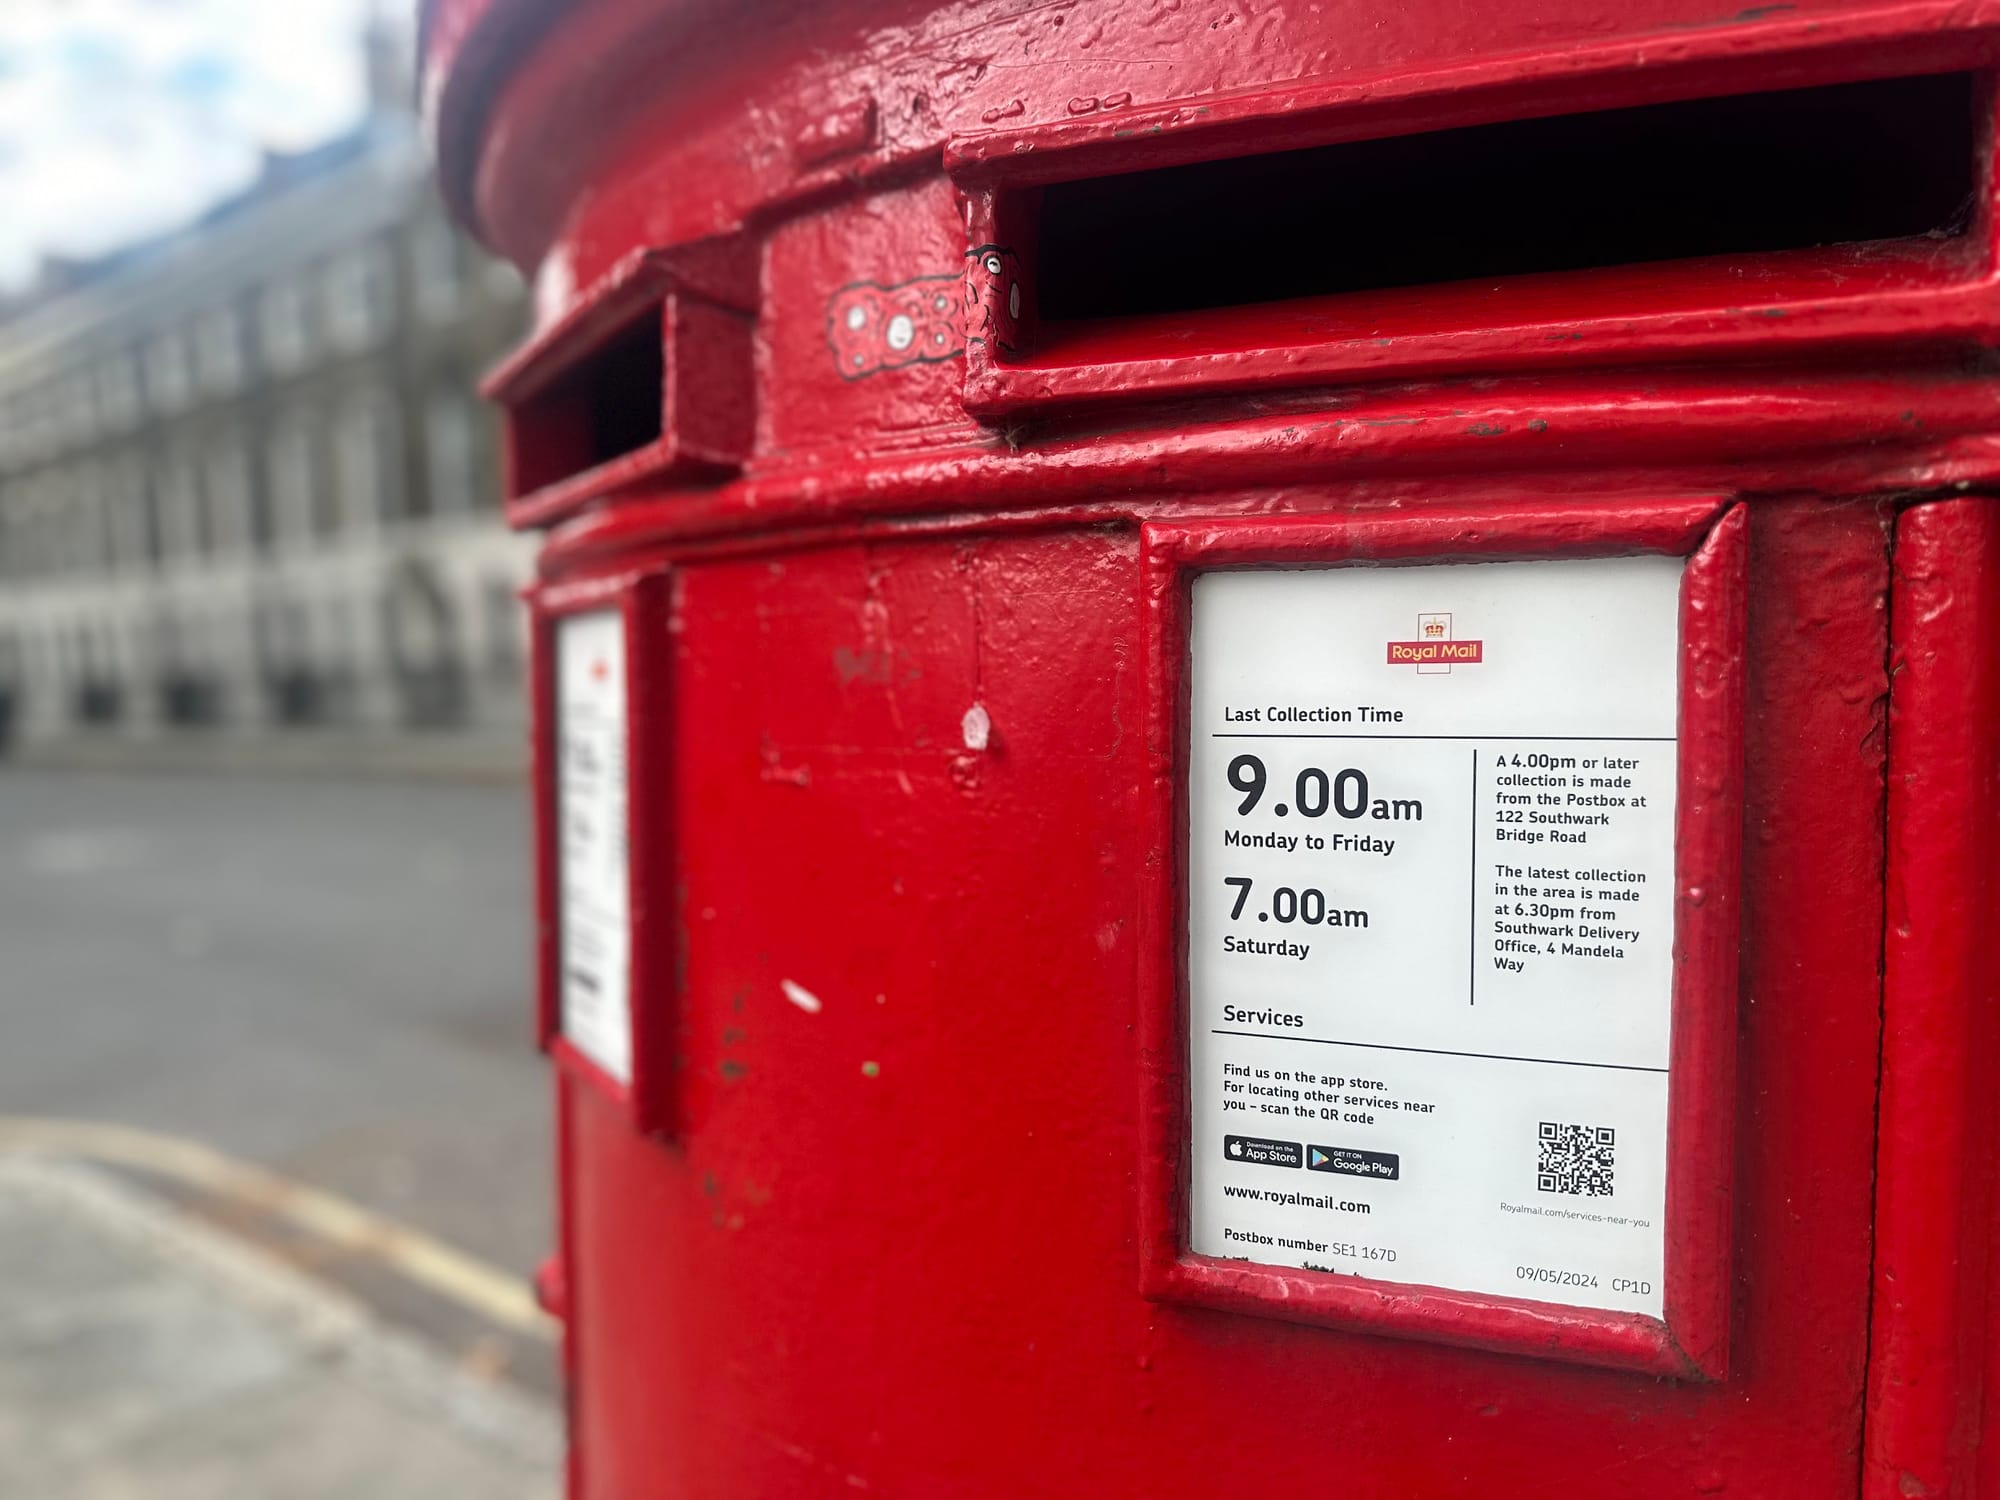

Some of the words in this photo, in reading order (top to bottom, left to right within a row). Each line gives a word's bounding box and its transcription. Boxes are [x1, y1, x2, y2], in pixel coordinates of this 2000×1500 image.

[1392, 644, 1437, 662] Royal
[1440, 643, 1477, 658] Mail
[1225, 706, 1261, 722] Last
[1267, 706, 1352, 723] Collection
[1357, 706, 1404, 723] Time
[1496, 755, 1507, 768] A
[1511, 753, 1576, 772] 4.00pm
[1582, 759, 1599, 769] or
[1603, 756, 1640, 770] later
[1226, 754, 1423, 821] 9.00am
[1496, 773, 1567, 787] collection
[1572, 774, 1585, 788] is
[1589, 775, 1632, 789] made
[1496, 791, 1532, 805] from
[1536, 792, 1561, 806] the
[1567, 793, 1626, 807] Postbox
[1630, 795, 1647, 808] at
[1495, 810, 1524, 823] 122
[1528, 810, 1610, 826] Southwark
[1224, 829, 1299, 853] Monday
[1304, 834, 1325, 850] to
[1333, 833, 1395, 857] Friday
[1496, 828, 1544, 845] Bridge
[1549, 829, 1587, 844] Road
[1494, 864, 1523, 878] The
[1527, 866, 1570, 880] latest
[1574, 868, 1646, 883] collection
[1495, 882, 1508, 896] in
[1513, 884, 1538, 897] the
[1542, 888, 1576, 899] area
[1581, 886, 1593, 900] is
[1598, 888, 1640, 902] made
[1223, 876, 1369, 929] 7.00am
[1494, 904, 1510, 916] at
[1514, 902, 1575, 921] 6.30pm
[1579, 906, 1616, 921] from
[1494, 920, 1574, 937] Southwark
[1578, 925, 1640, 943] Delivery
[1223, 935, 1310, 961] Saturday
[1494, 938, 1541, 955] Office,
[1546, 941, 1556, 955] 4
[1561, 942, 1624, 959] Mandela
[1493, 956, 1525, 974] Way
[1223, 1004, 1304, 1028] Services
[1223, 1063, 1251, 1077] Find
[1255, 1069, 1270, 1079] us
[1274, 1071, 1290, 1081] on
[1294, 1071, 1316, 1084] the
[1320, 1075, 1345, 1089] app
[1349, 1077, 1388, 1091] store.
[1223, 1079, 1245, 1094] For
[1248, 1082, 1299, 1102] locating
[1303, 1090, 1340, 1104] other
[1343, 1095, 1399, 1110] services
[1403, 1102, 1436, 1113] near
[1223, 1099, 1246, 1111] you
[1260, 1103, 1290, 1116] scan
[1294, 1105, 1316, 1119] the
[1320, 1107, 1339, 1121] QR
[1343, 1112, 1375, 1125] code
[1245, 1147, 1268, 1161] App
[1268, 1150, 1297, 1163] Store
[1246, 1141, 1275, 1150] Download
[1333, 1150, 1346, 1158] GET
[1352, 1152, 1362, 1160] ON
[1333, 1157, 1371, 1174] Google
[1372, 1162, 1394, 1177] Play
[1223, 1185, 1371, 1215] www.royalmail.com
[1500, 1201, 1650, 1229] Royalmail.com/services-near-you
[1224, 1227, 1274, 1246] Postbox
[1277, 1238, 1329, 1253] number
[1332, 1242, 1357, 1258] SE1
[1361, 1246, 1397, 1262] 167D
[1516, 1266, 1598, 1289] 09/05/2024
[1612, 1278, 1651, 1295] CP1D
